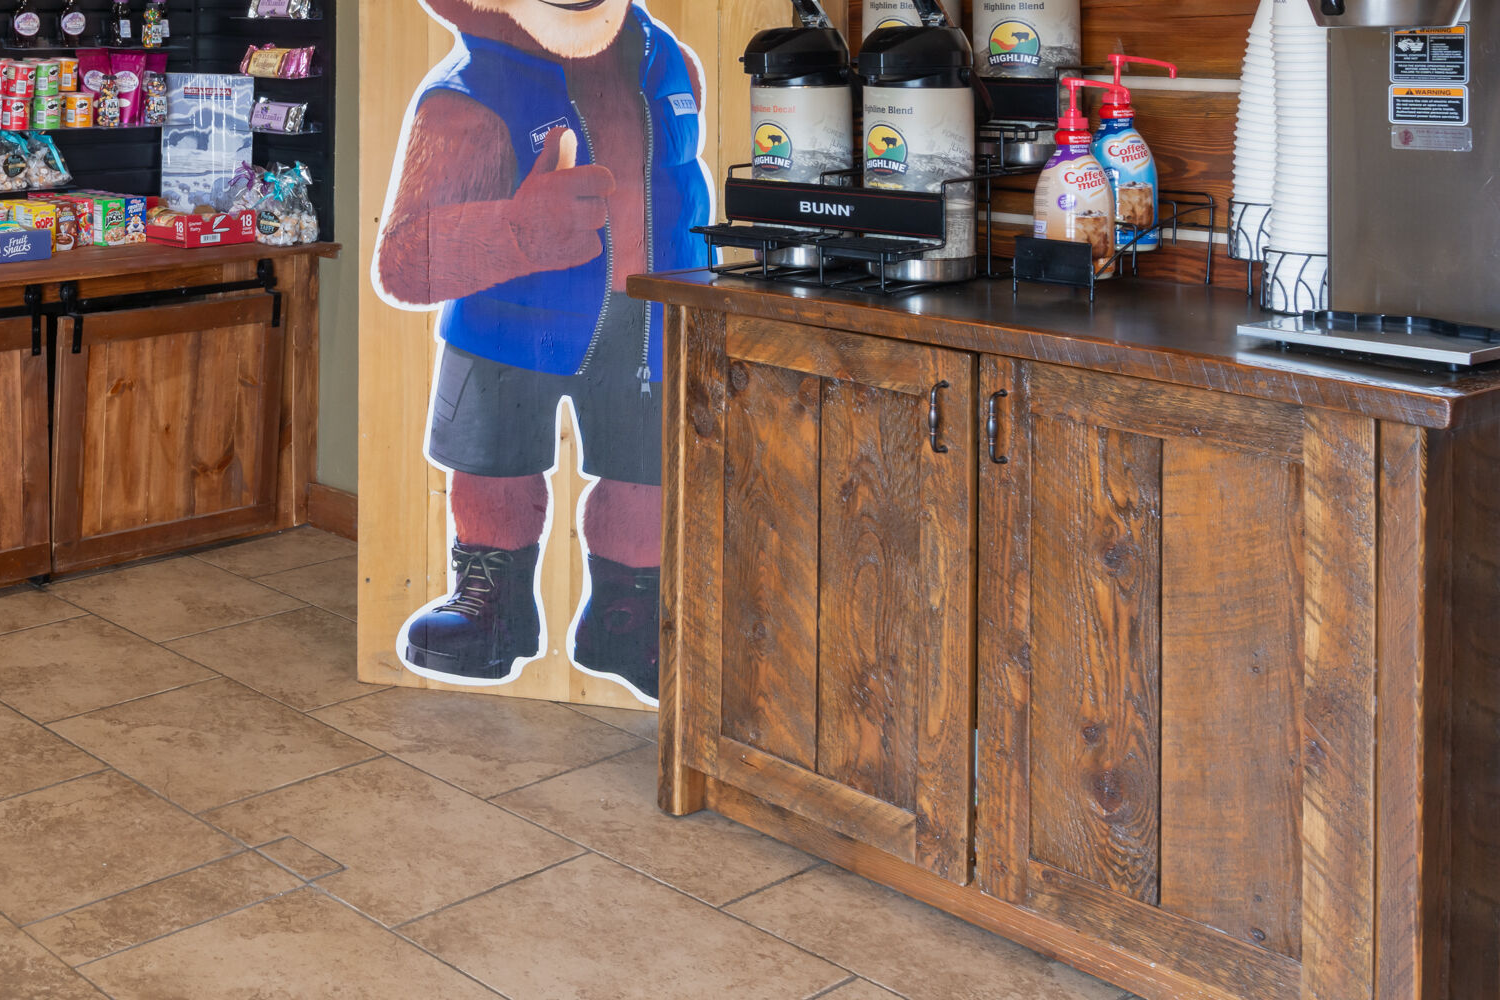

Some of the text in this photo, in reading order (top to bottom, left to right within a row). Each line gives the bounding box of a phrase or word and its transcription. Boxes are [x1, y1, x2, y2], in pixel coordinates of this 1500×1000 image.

[984, 2, 1045, 12] Highline Blend
[988, 54, 1040, 66] HIGHLINE
[888, 106, 913, 115] Blend
[1108, 144, 1145, 157] Coffee
[1122, 150, 1148, 163] mate
[754, 156, 791, 168] HIGHLINE
[866, 161, 906, 173] HIGHLINE
[1064, 170, 1103, 184] Coffee
[1078, 177, 1106, 190] mate
[800, 201, 850, 217] BUNN
[241, 214, 252, 227] 18
[9, 235, 28, 247] Fruit
[3, 243, 31, 257] Snacks
